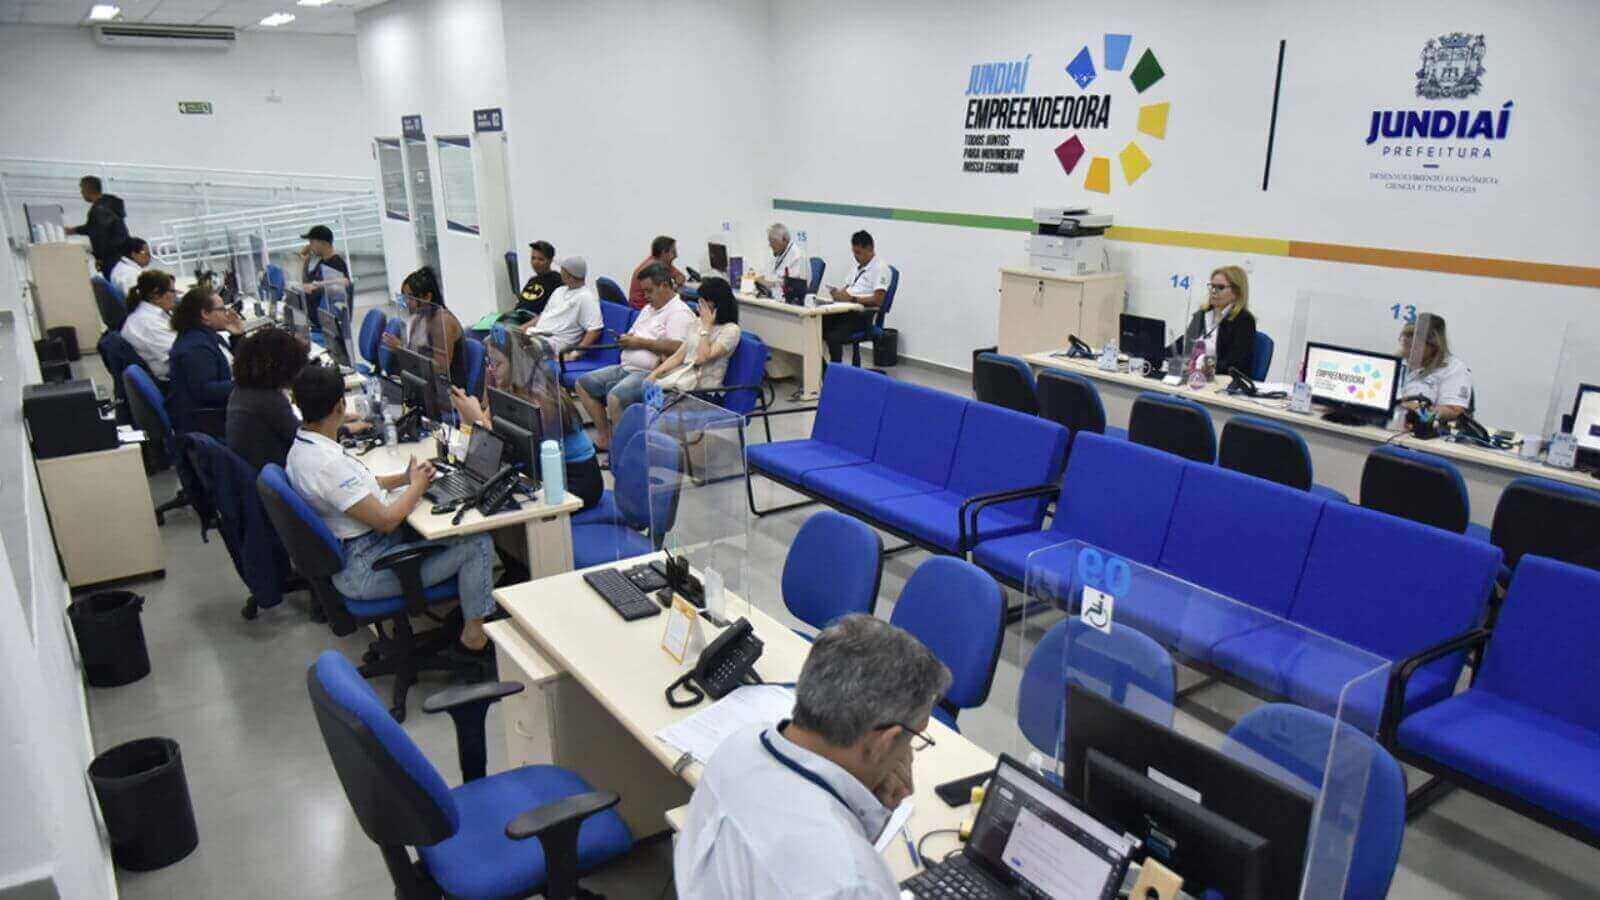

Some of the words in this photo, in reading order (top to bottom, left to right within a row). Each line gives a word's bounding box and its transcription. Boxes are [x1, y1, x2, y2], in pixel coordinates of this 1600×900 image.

[965, 54, 1032, 95] JUNDIAÍ
[965, 95, 1111, 129] EMPREENDEDORA
[1366, 100, 1514, 145] JUNDIAÍ
[964, 134, 985, 146] TODOS
[986, 134, 1011, 146] JUNTOS
[963, 148, 981, 159] PARA
[981, 148, 1025, 160] MOVIMENTAR
[1382, 146, 1492, 159] PREFEITURA
[963, 161, 984, 172] NOSSA
[984, 162, 1019, 174] ECONOMIA
[796, 231, 808, 241] 15
[1170, 274, 1191, 290] 14
[1390, 303, 1417, 324] 13
